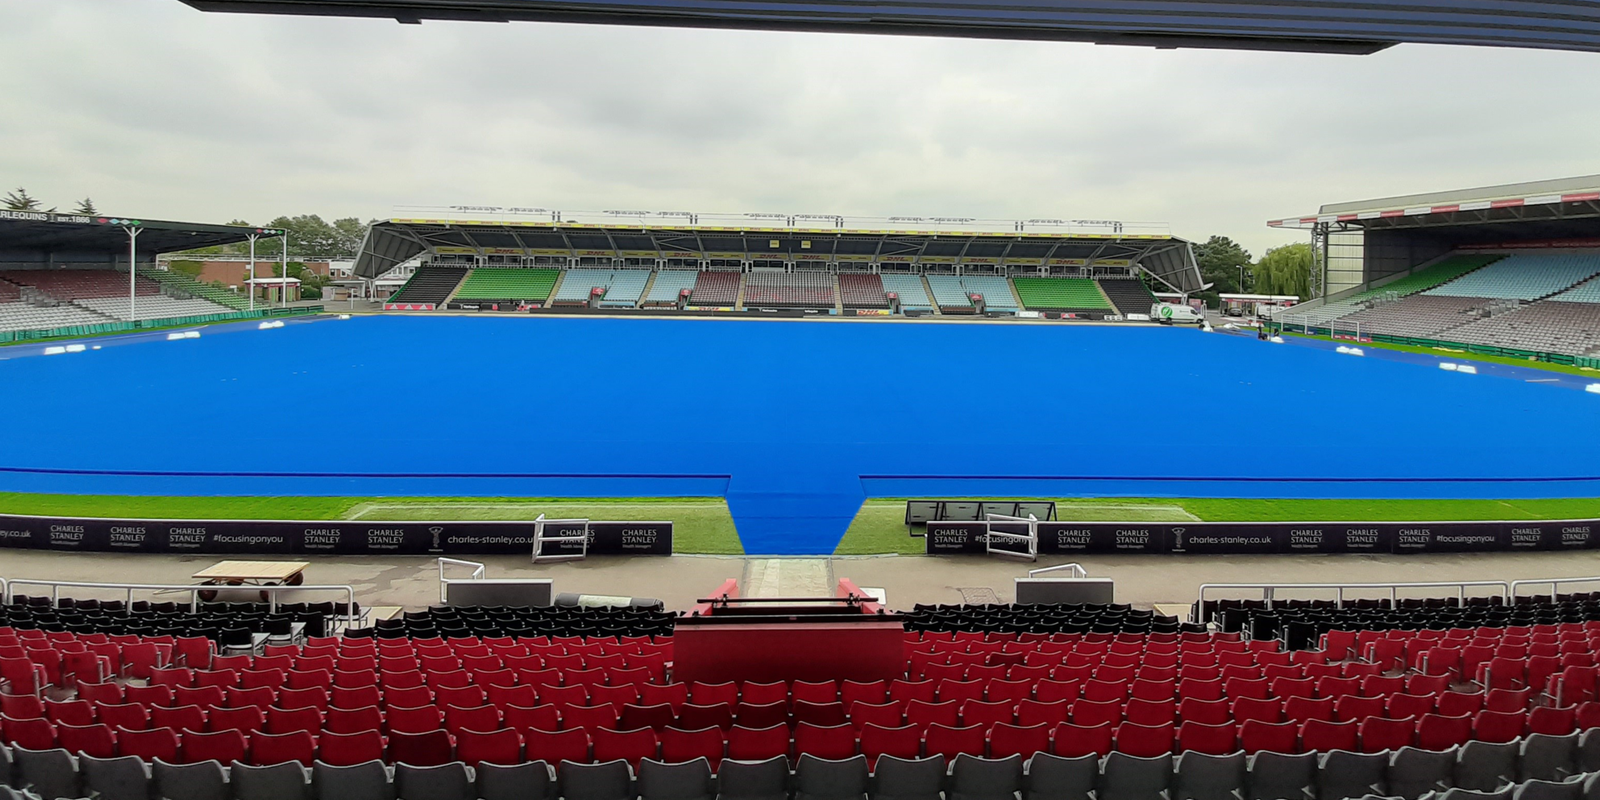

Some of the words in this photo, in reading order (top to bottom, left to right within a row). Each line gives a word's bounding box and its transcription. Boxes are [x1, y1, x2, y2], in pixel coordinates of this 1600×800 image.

[0, 210, 48, 220] RLEQUINS
[50, 525, 84, 533] CHARLES
[110, 526, 146, 534] CHARLES
[1562, 526, 1590, 534] CHARLES
[50, 532, 84, 540] STANLEY
[213, 534, 284, 544] #focusingonyou
[447, 536, 534, 545] charles-stanley.co.u
[1189, 536, 1272, 545] charles-stanley.co.uk
[1436, 535, 1494, 544] #focusingonyou
